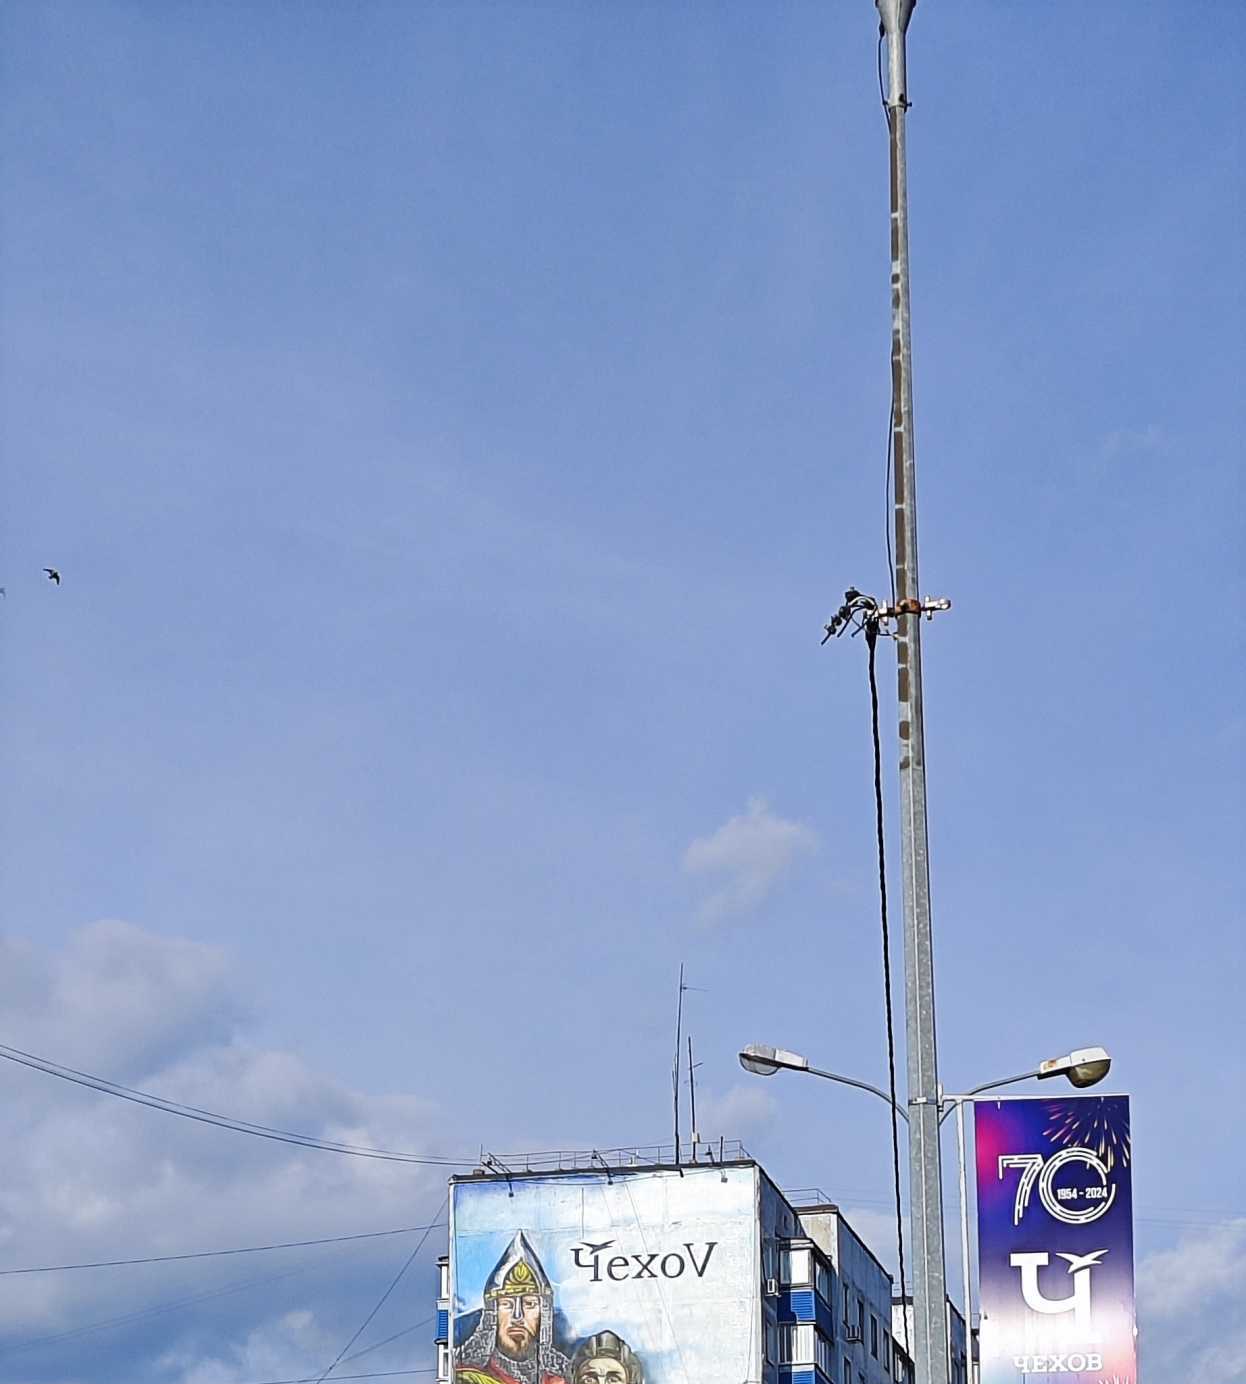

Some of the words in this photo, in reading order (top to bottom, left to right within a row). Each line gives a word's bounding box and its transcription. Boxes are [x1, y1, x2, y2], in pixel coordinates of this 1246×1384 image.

[998, 1147, 1116, 1226] 70
[1057, 1188, 1078, 1200] 1954
[1085, 1187, 1108, 1199] 2024
[1010, 1250, 1108, 1344] Ч
[1012, 1353, 1103, 1374] ЧЕХОВ
